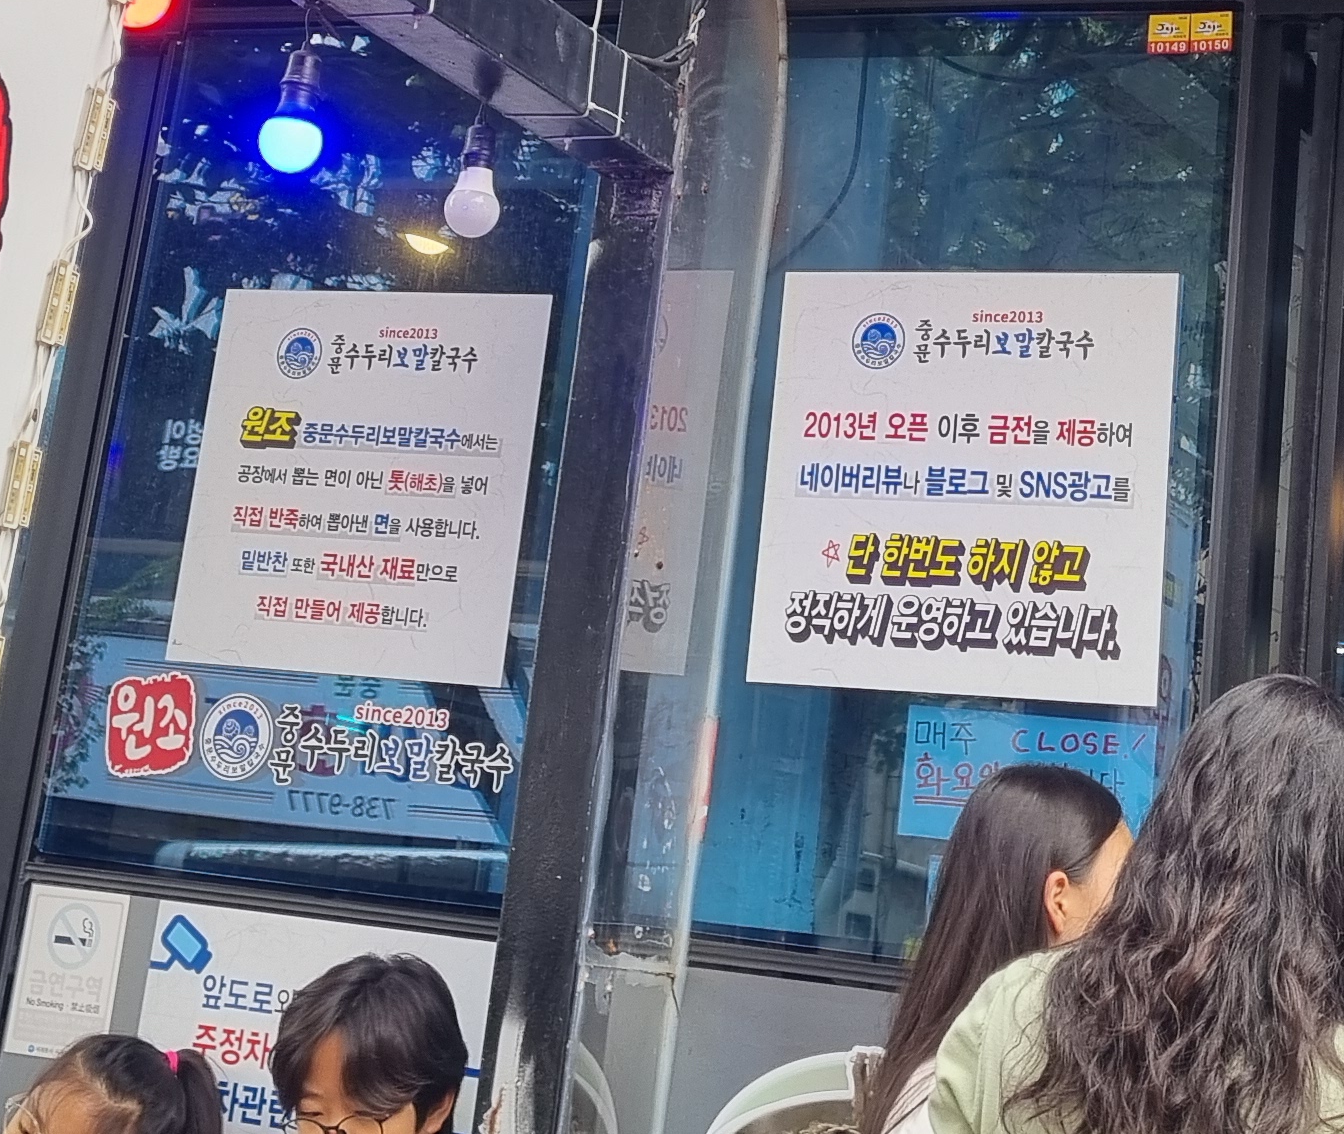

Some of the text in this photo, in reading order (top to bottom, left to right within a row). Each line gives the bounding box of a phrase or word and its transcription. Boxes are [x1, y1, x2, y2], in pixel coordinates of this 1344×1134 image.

[1149, 41, 1187, 53] 10149
[1192, 39, 1229, 52] 10150
[378, 326, 439, 340] since2013
[972, 310, 1044, 324] since2013
[344, 344, 479, 374] 수두리보말칼국수
[932, 328, 1095, 361] 수두리보말칼국수
[241, 405, 299, 446] 원조
[303, 422, 498, 452] 중문수두리보말칼국수에서는
[803, 411, 1134, 448] 2013년 오픈 이후 금전을 제공하여
[237, 464, 489, 495] 공장에서 뽑는 면이 아닌 톳(해초)을 넣어
[799, 463, 1132, 503] 네이버리뷰나 블로그 및 SNS광고를
[233, 505, 481, 541] 직접 반죽하여 뽑아낸 면을 사용합니다.
[241, 550, 458, 583] 밑반찬 또한 국내산 재료만으로
[846, 533, 1088, 591] 단 한번도 하지 않고
[257, 595, 427, 628] 직접 만들어 제공합니다.
[785, 590, 1120, 658] 정직하게 운영하고 있습니다.
[111, 684, 188, 763] 원조
[355, 702, 449, 730] since2013
[914, 721, 978, 755] 매주
[1012, 729, 1146, 759] CLOSE!
[299, 723, 514, 792] 수두리보말칼국수
[29, 969, 104, 1003] 금연구역
[26, 997, 64, 1012] No Smoking
